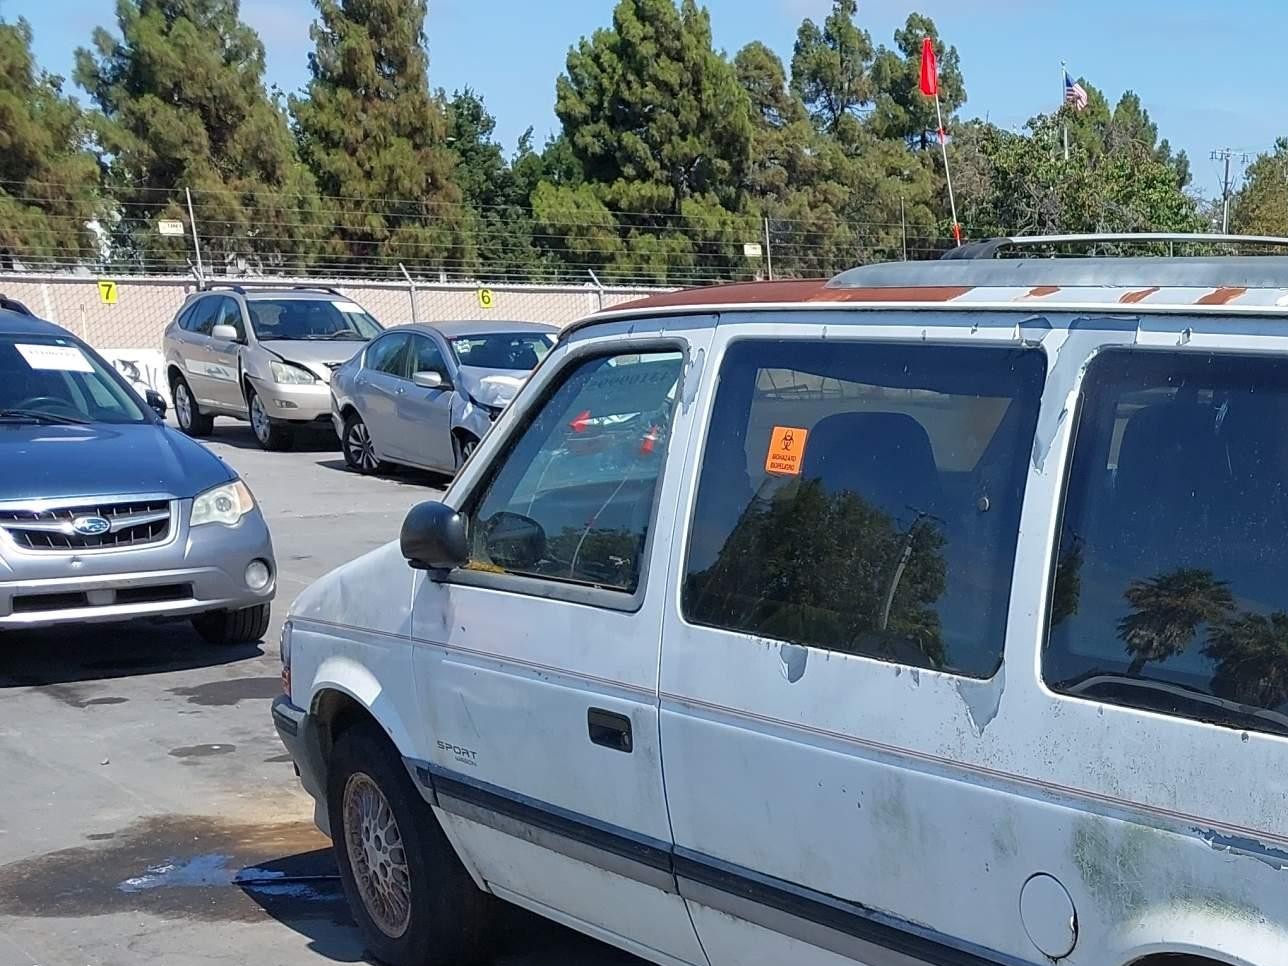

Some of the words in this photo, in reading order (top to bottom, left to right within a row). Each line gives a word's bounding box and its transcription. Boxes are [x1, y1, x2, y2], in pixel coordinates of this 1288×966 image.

[100, 284, 112, 300] 7
[481, 289, 491, 305] 6
[437, 740, 478, 760] SPORT
